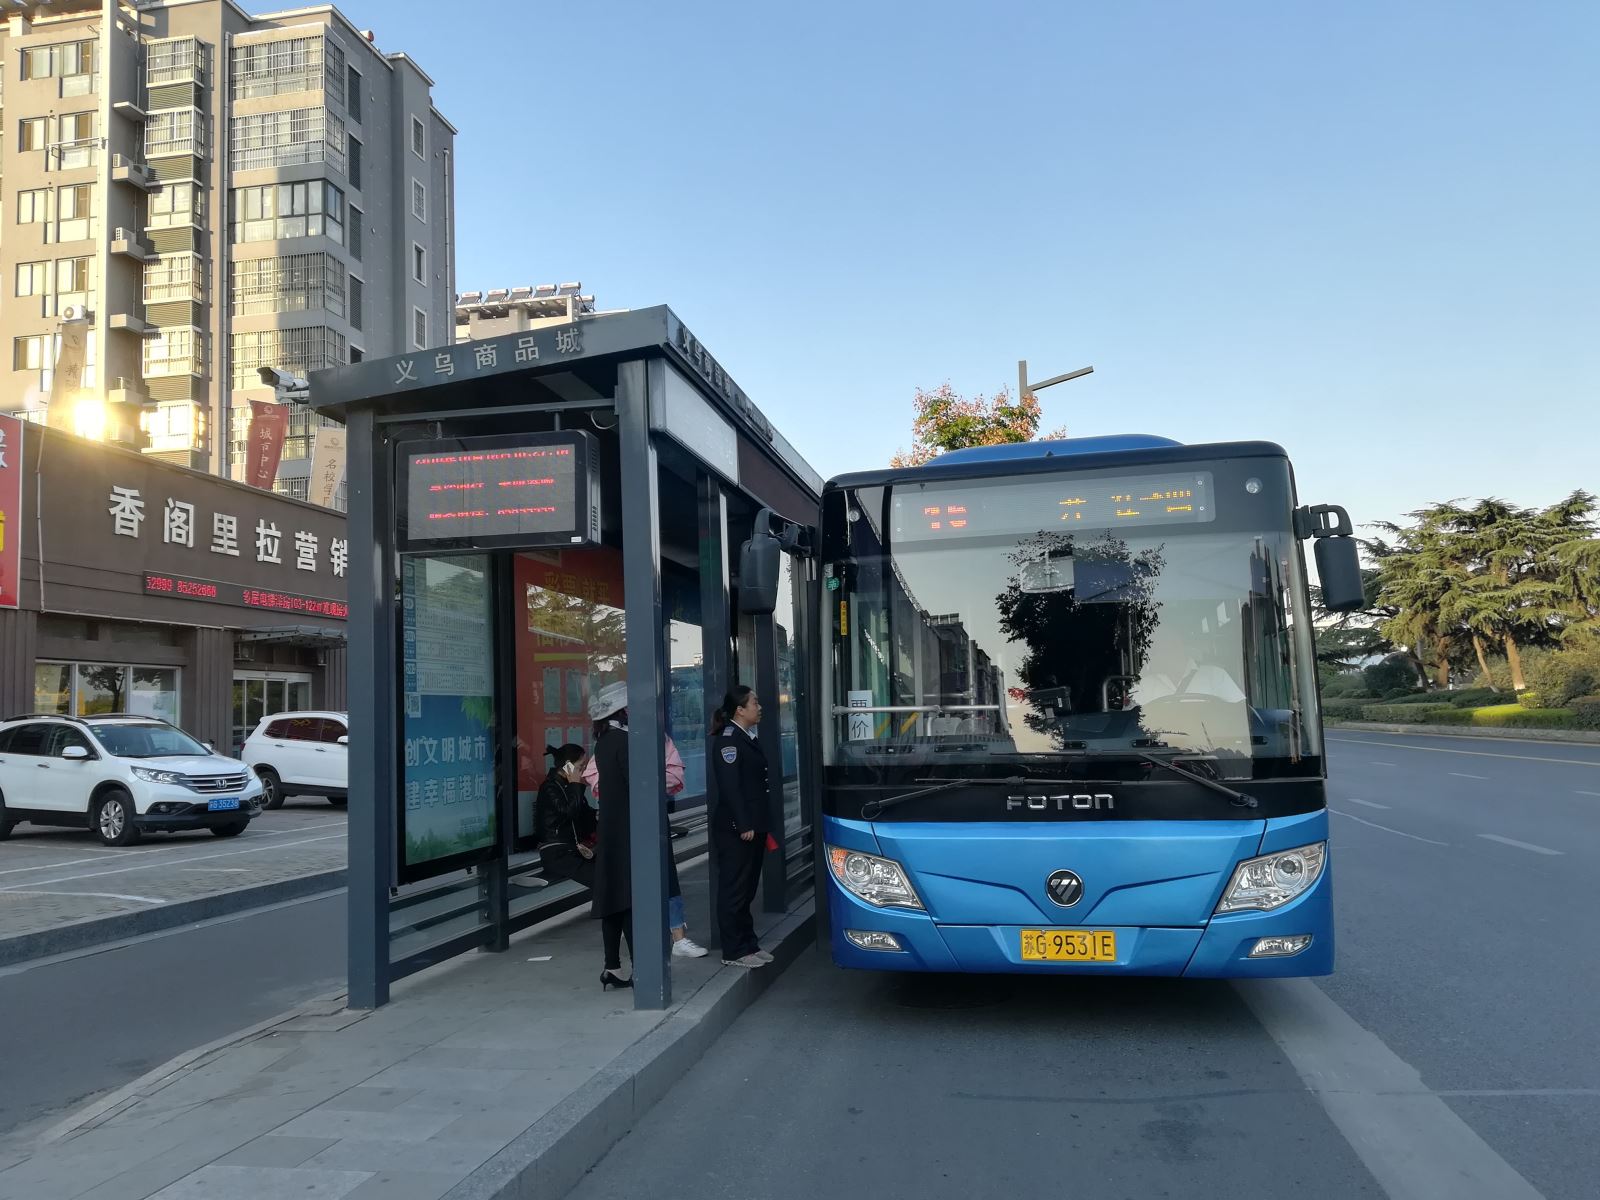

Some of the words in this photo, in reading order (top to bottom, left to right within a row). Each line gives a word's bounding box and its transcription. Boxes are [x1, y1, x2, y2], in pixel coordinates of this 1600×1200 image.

[395, 327, 582, 385] 义乌商品城
[108, 484, 348, 578] 香阁里拉营销
[405, 735, 487, 767] 创文明城市
[1006, 794, 1114, 811] FOTON
